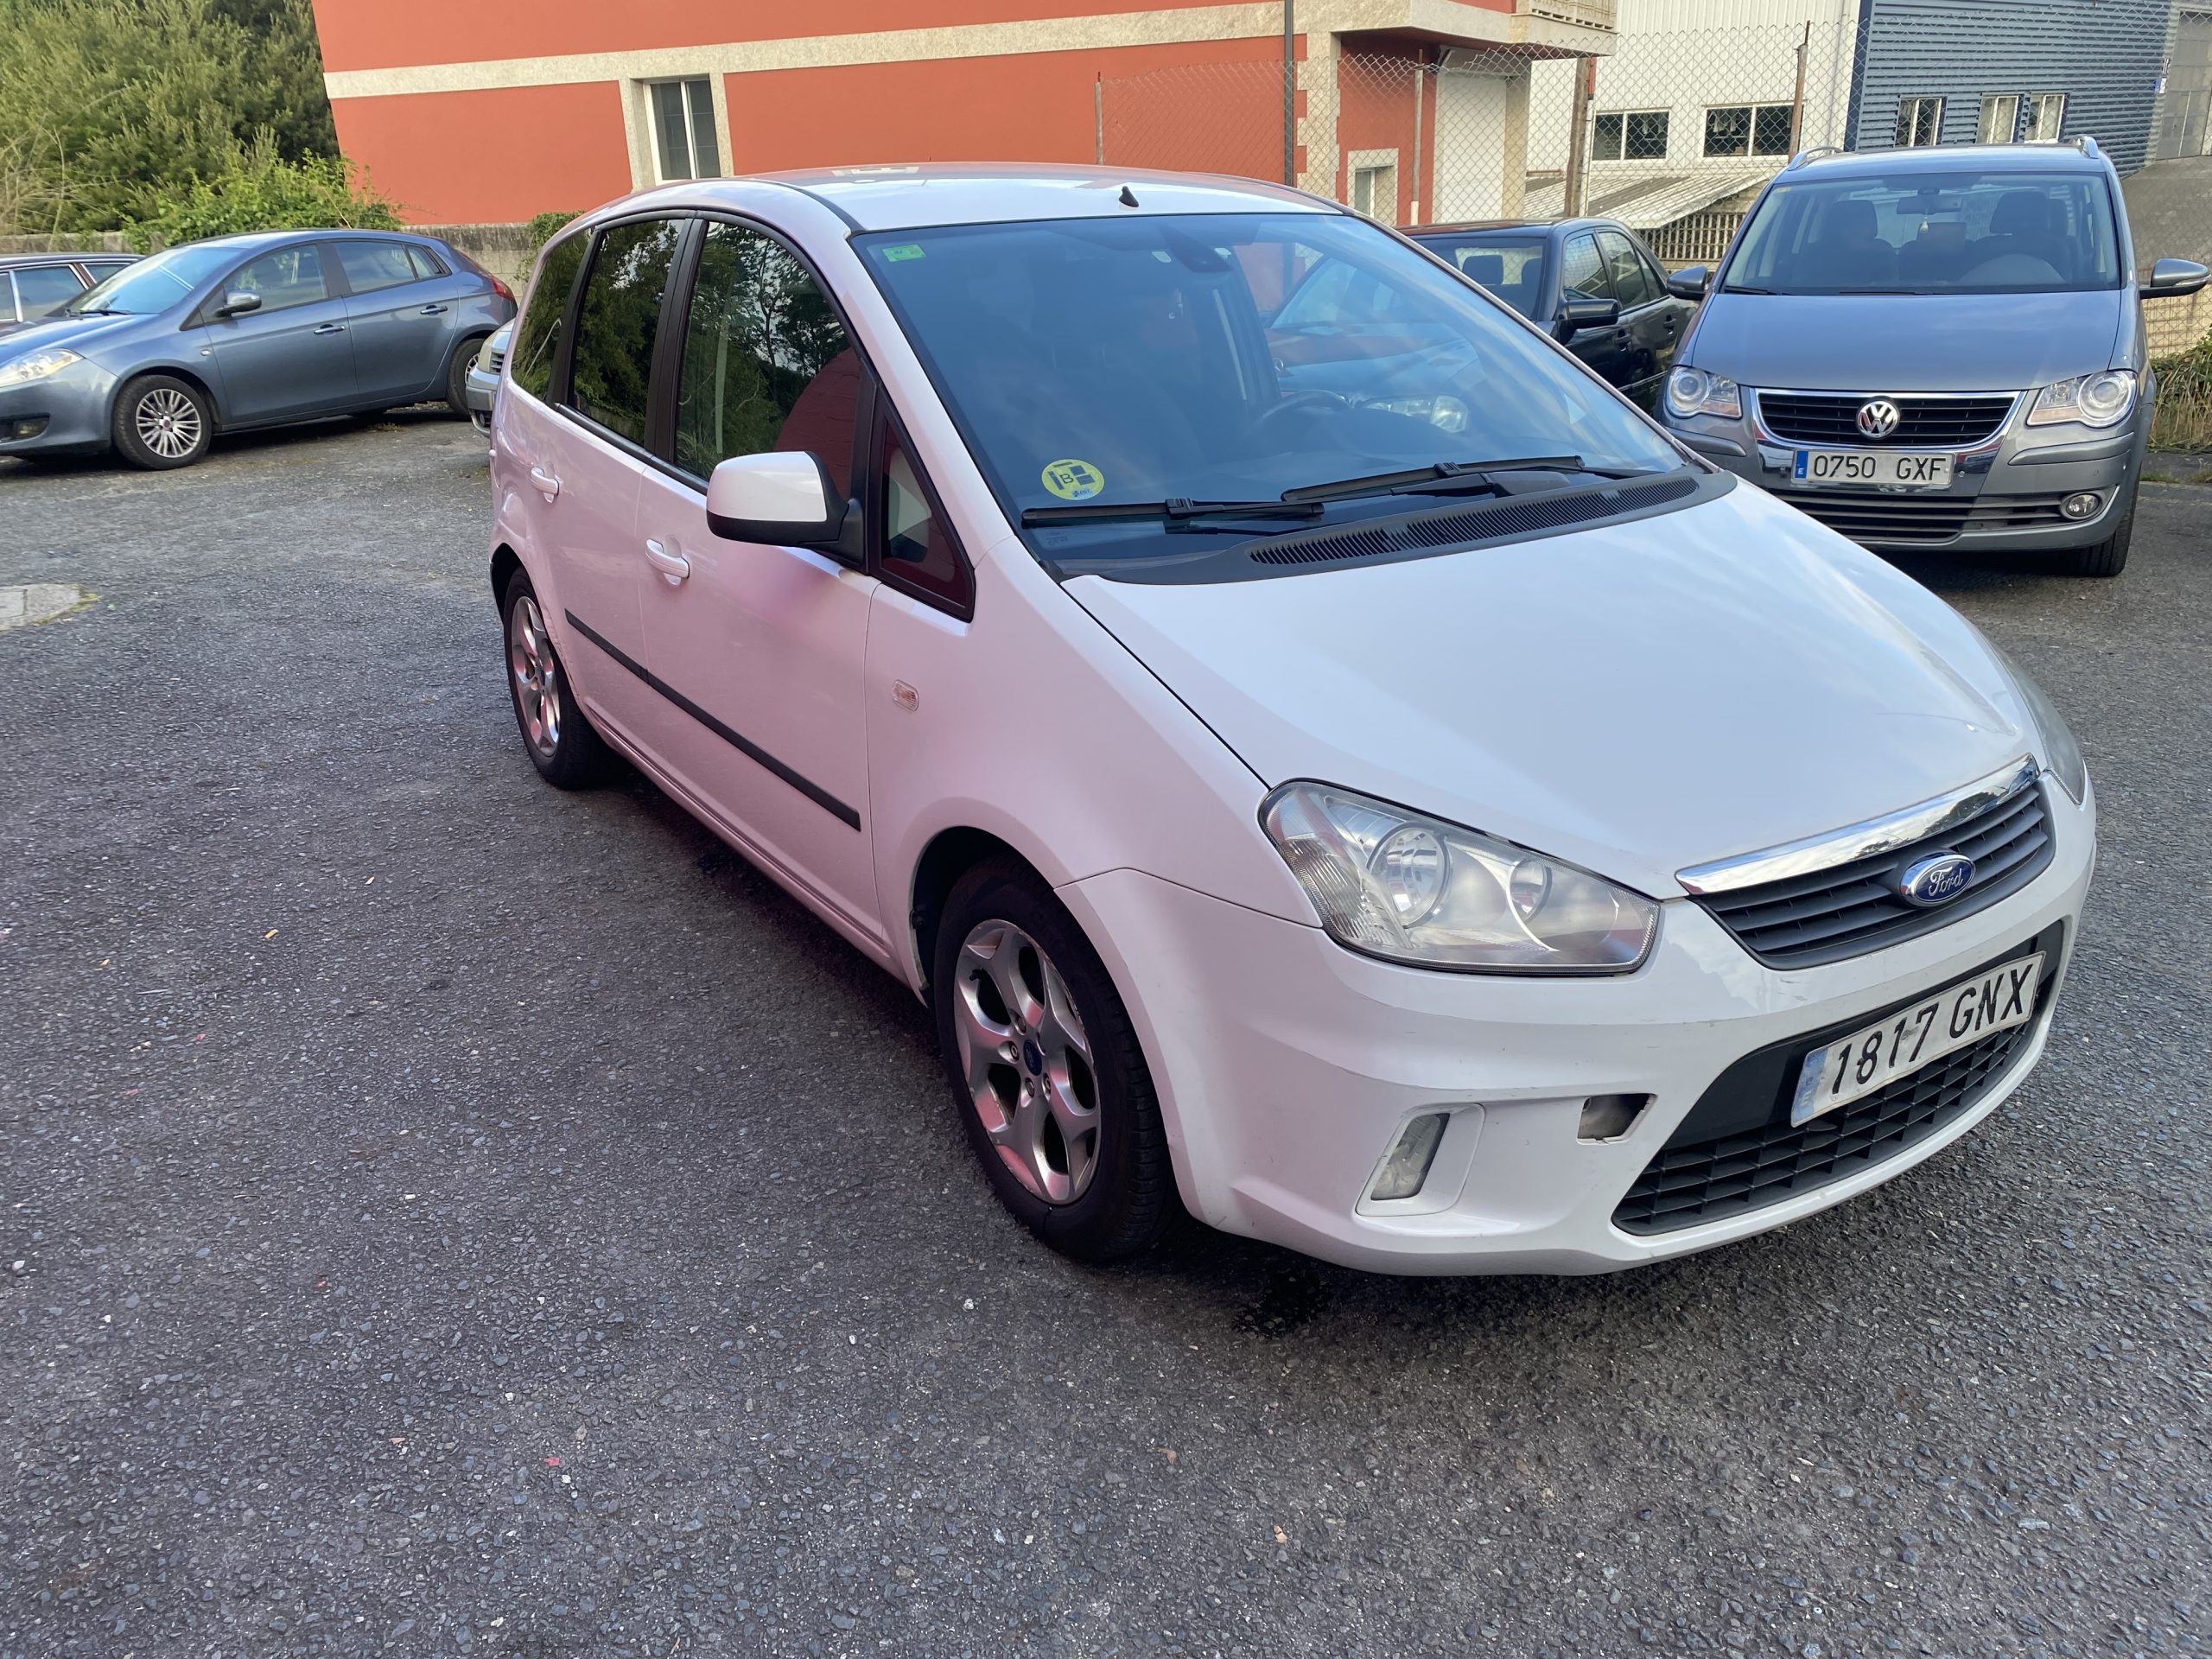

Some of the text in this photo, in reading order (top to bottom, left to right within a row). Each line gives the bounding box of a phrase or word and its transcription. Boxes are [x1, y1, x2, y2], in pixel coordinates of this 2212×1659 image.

[1059, 474, 1073, 484] B
[1815, 455, 1876, 478] 0750
[1897, 457, 1946, 480] GXF
[1929, 866, 1964, 896] Ford
[1831, 1002, 1940, 1095] 1817
[1949, 963, 2033, 1039] GNX
